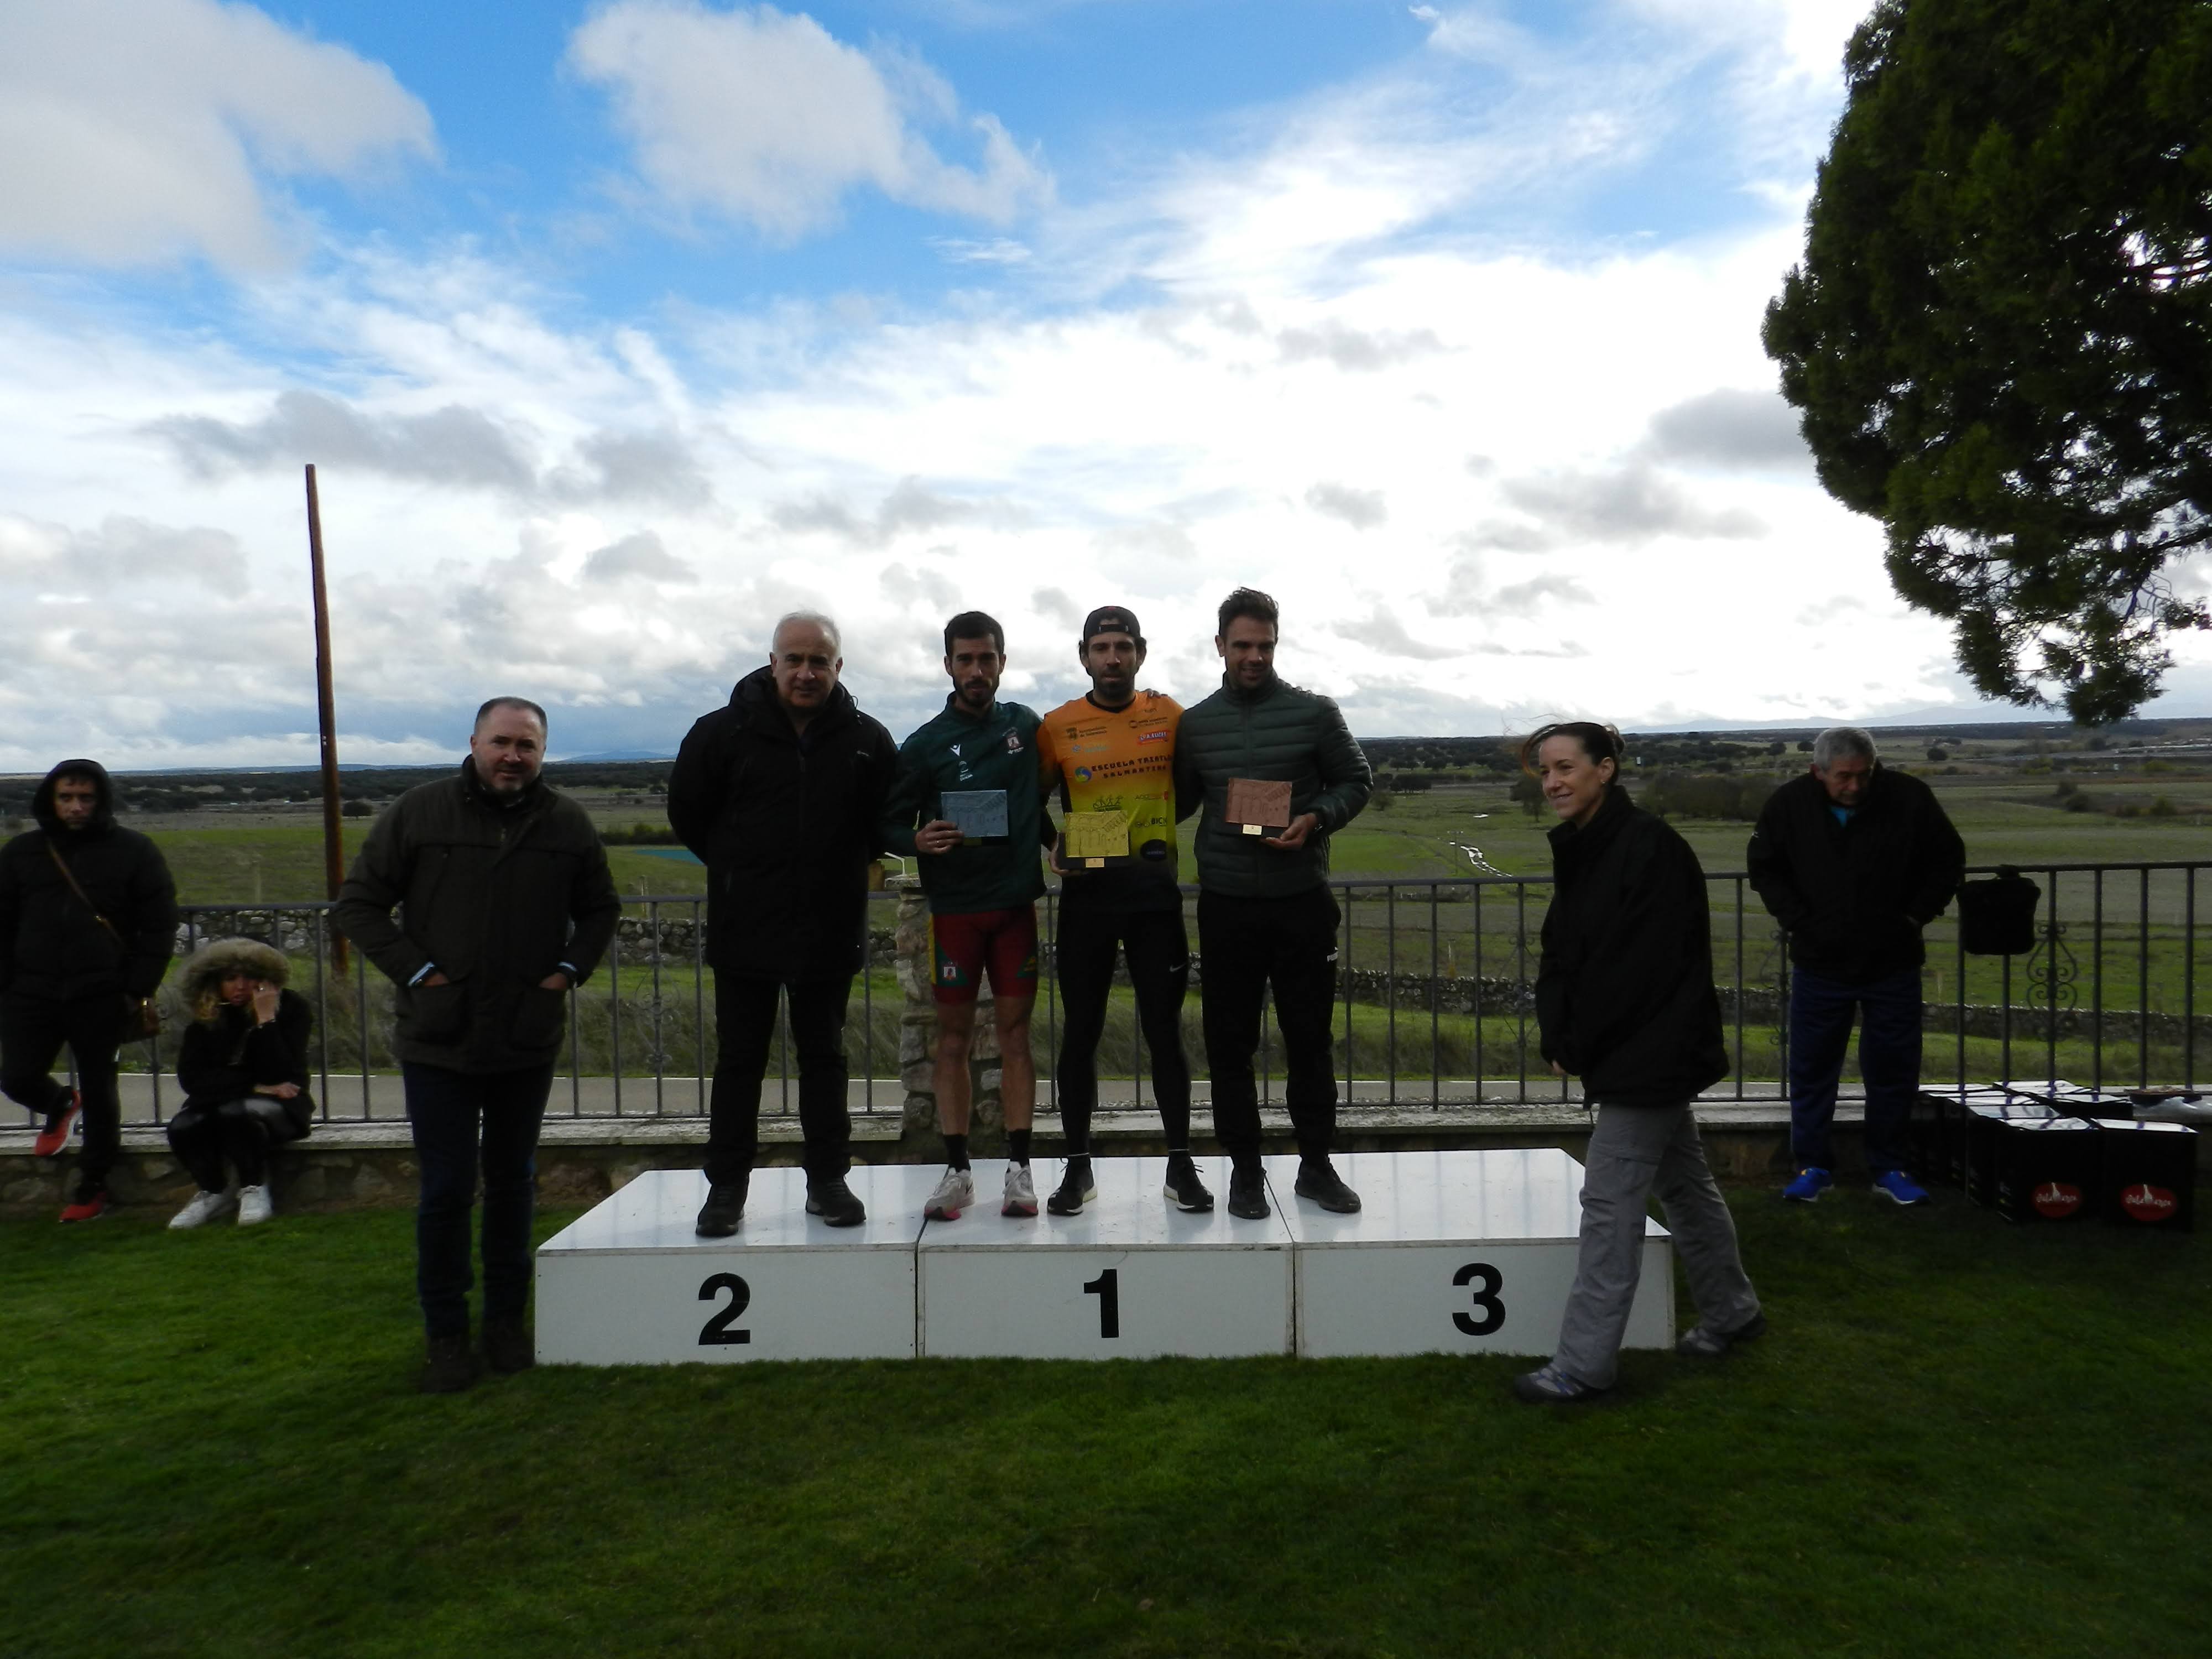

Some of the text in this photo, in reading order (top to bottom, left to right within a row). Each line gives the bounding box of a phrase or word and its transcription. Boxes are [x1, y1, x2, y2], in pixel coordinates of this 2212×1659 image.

[1091, 759, 1135, 772] ESCUELA
[698, 1272, 750, 1345] 2
[1084, 1269, 1119, 1338] 1
[1452, 1263, 1506, 1336] 3
